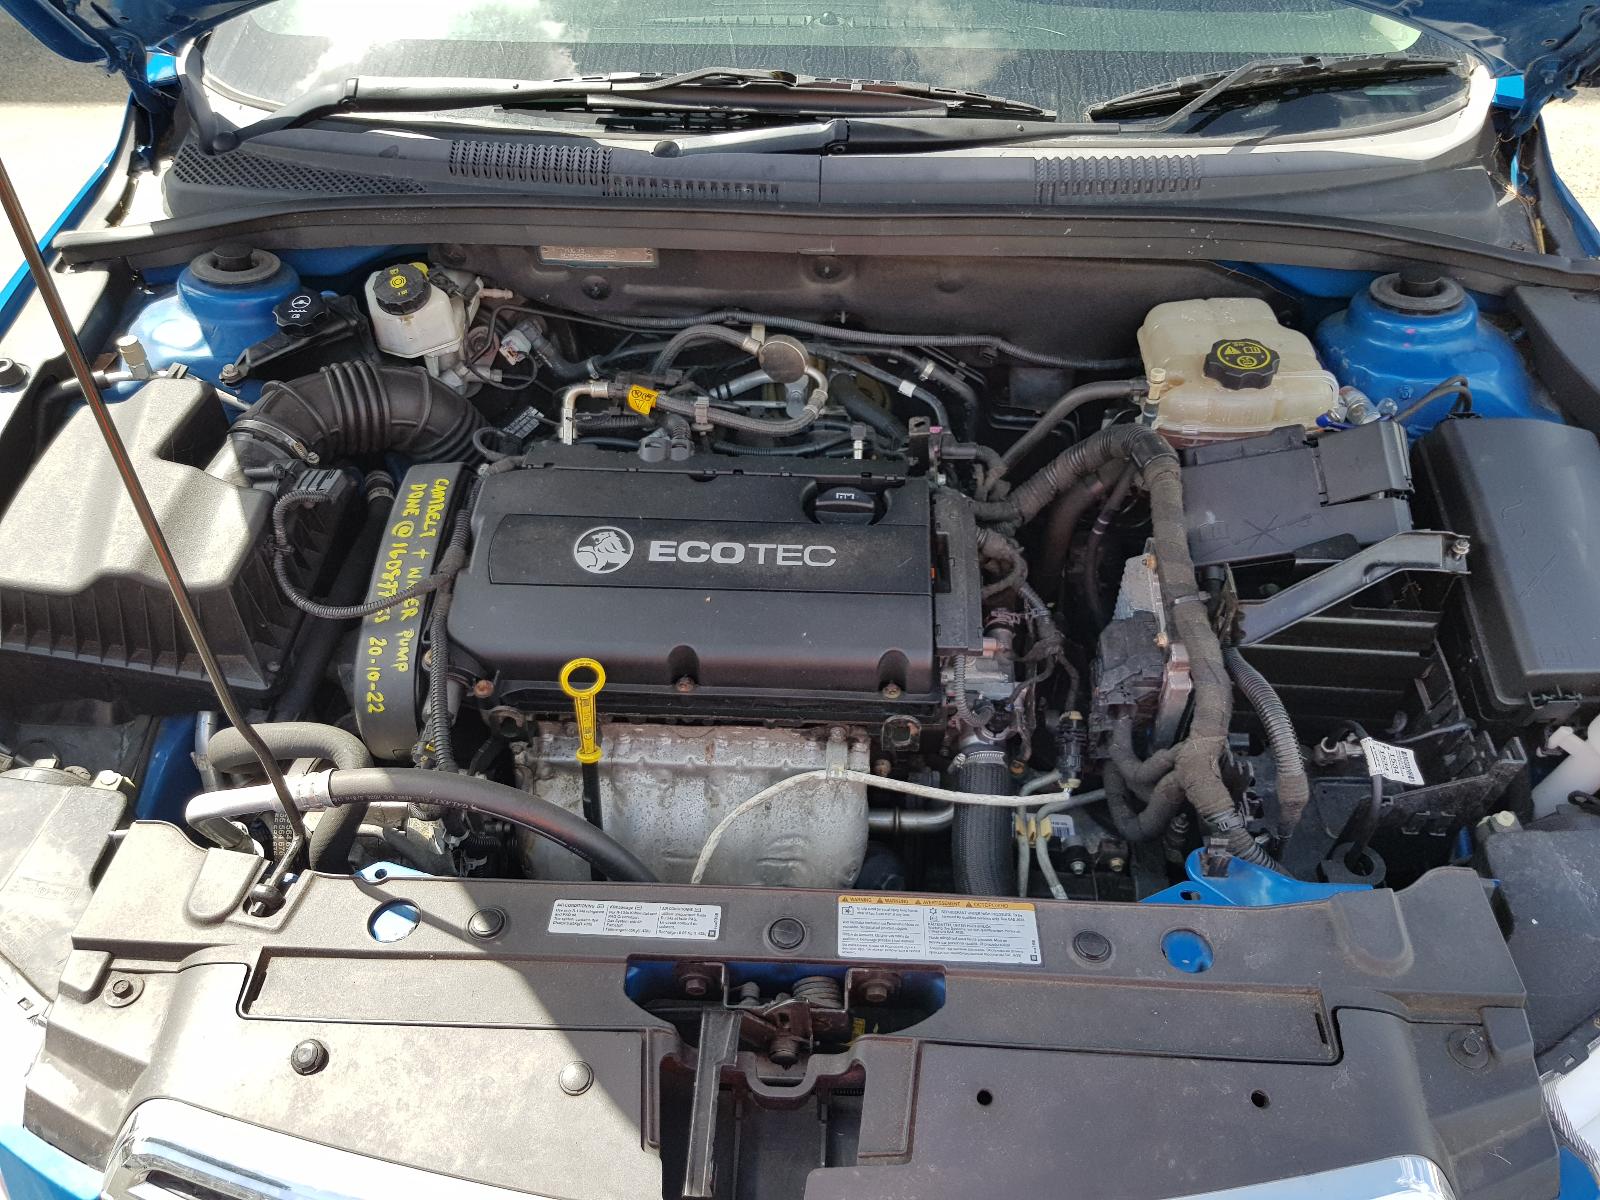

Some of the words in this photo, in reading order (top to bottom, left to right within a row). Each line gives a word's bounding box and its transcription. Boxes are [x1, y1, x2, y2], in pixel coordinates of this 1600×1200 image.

[402, 483, 428, 516] DONE
[419, 478, 451, 538] CAMBELT
[648, 540, 837, 567] ECOTEC
[400, 566, 425, 622] WAER
[390, 628, 415, 672] PUMP
